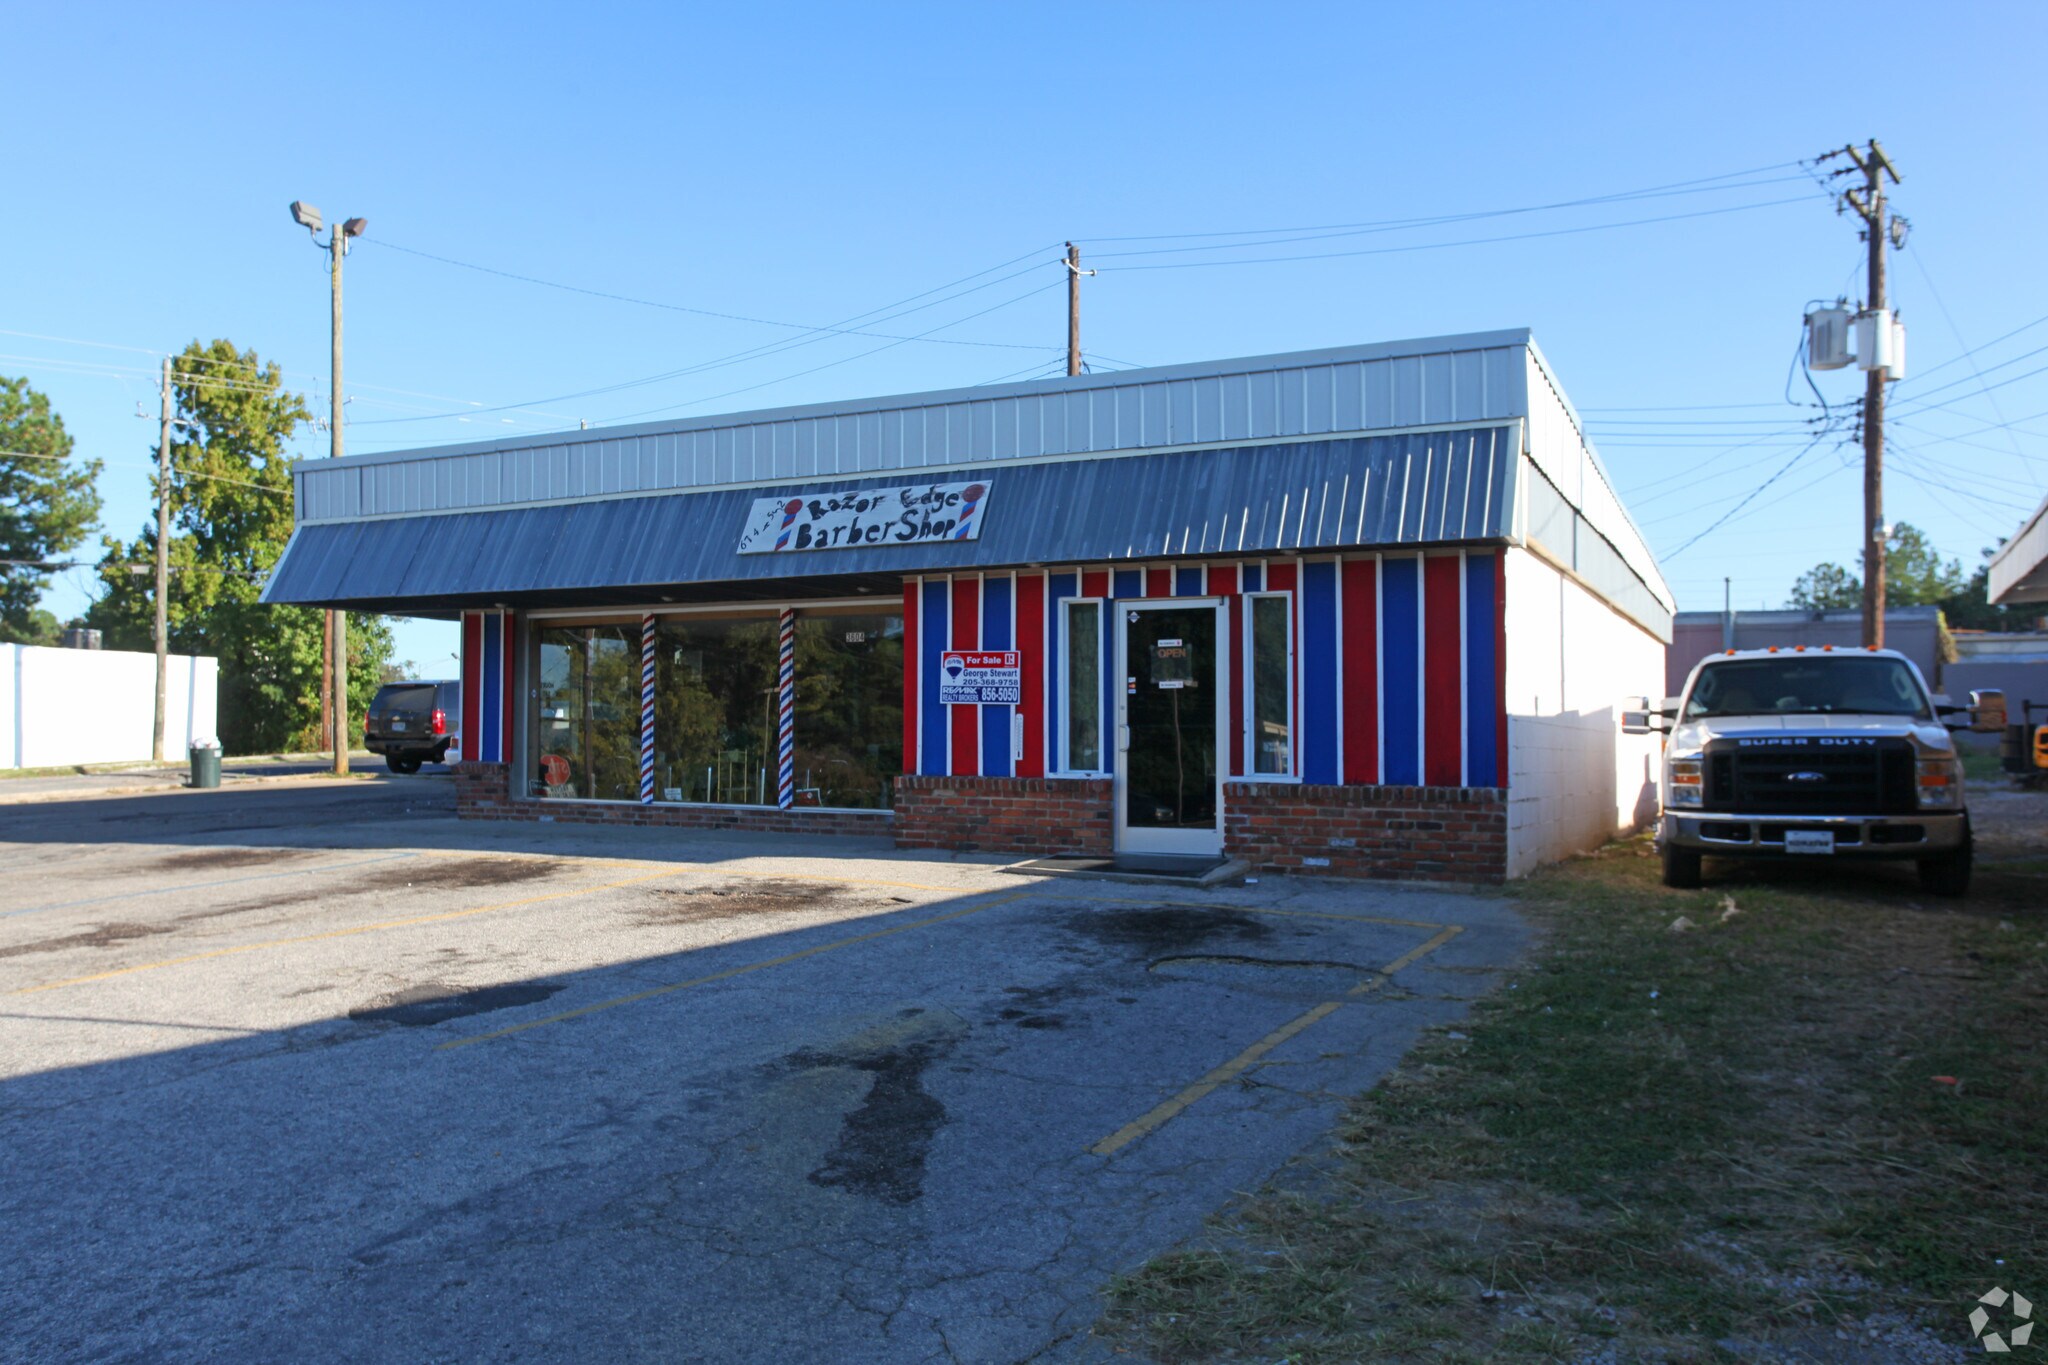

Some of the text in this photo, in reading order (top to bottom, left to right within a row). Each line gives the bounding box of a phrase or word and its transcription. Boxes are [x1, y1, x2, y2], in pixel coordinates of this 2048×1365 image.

[807, 485, 960, 521] Razor Edge
[1157, 648, 1187, 658] OPEN
[966, 656, 1002, 664] For Sale
[963, 669, 1018, 679] George Stewart
[981, 687, 1018, 701] 856-5050
[1738, 738, 1808, 746] SUPER
